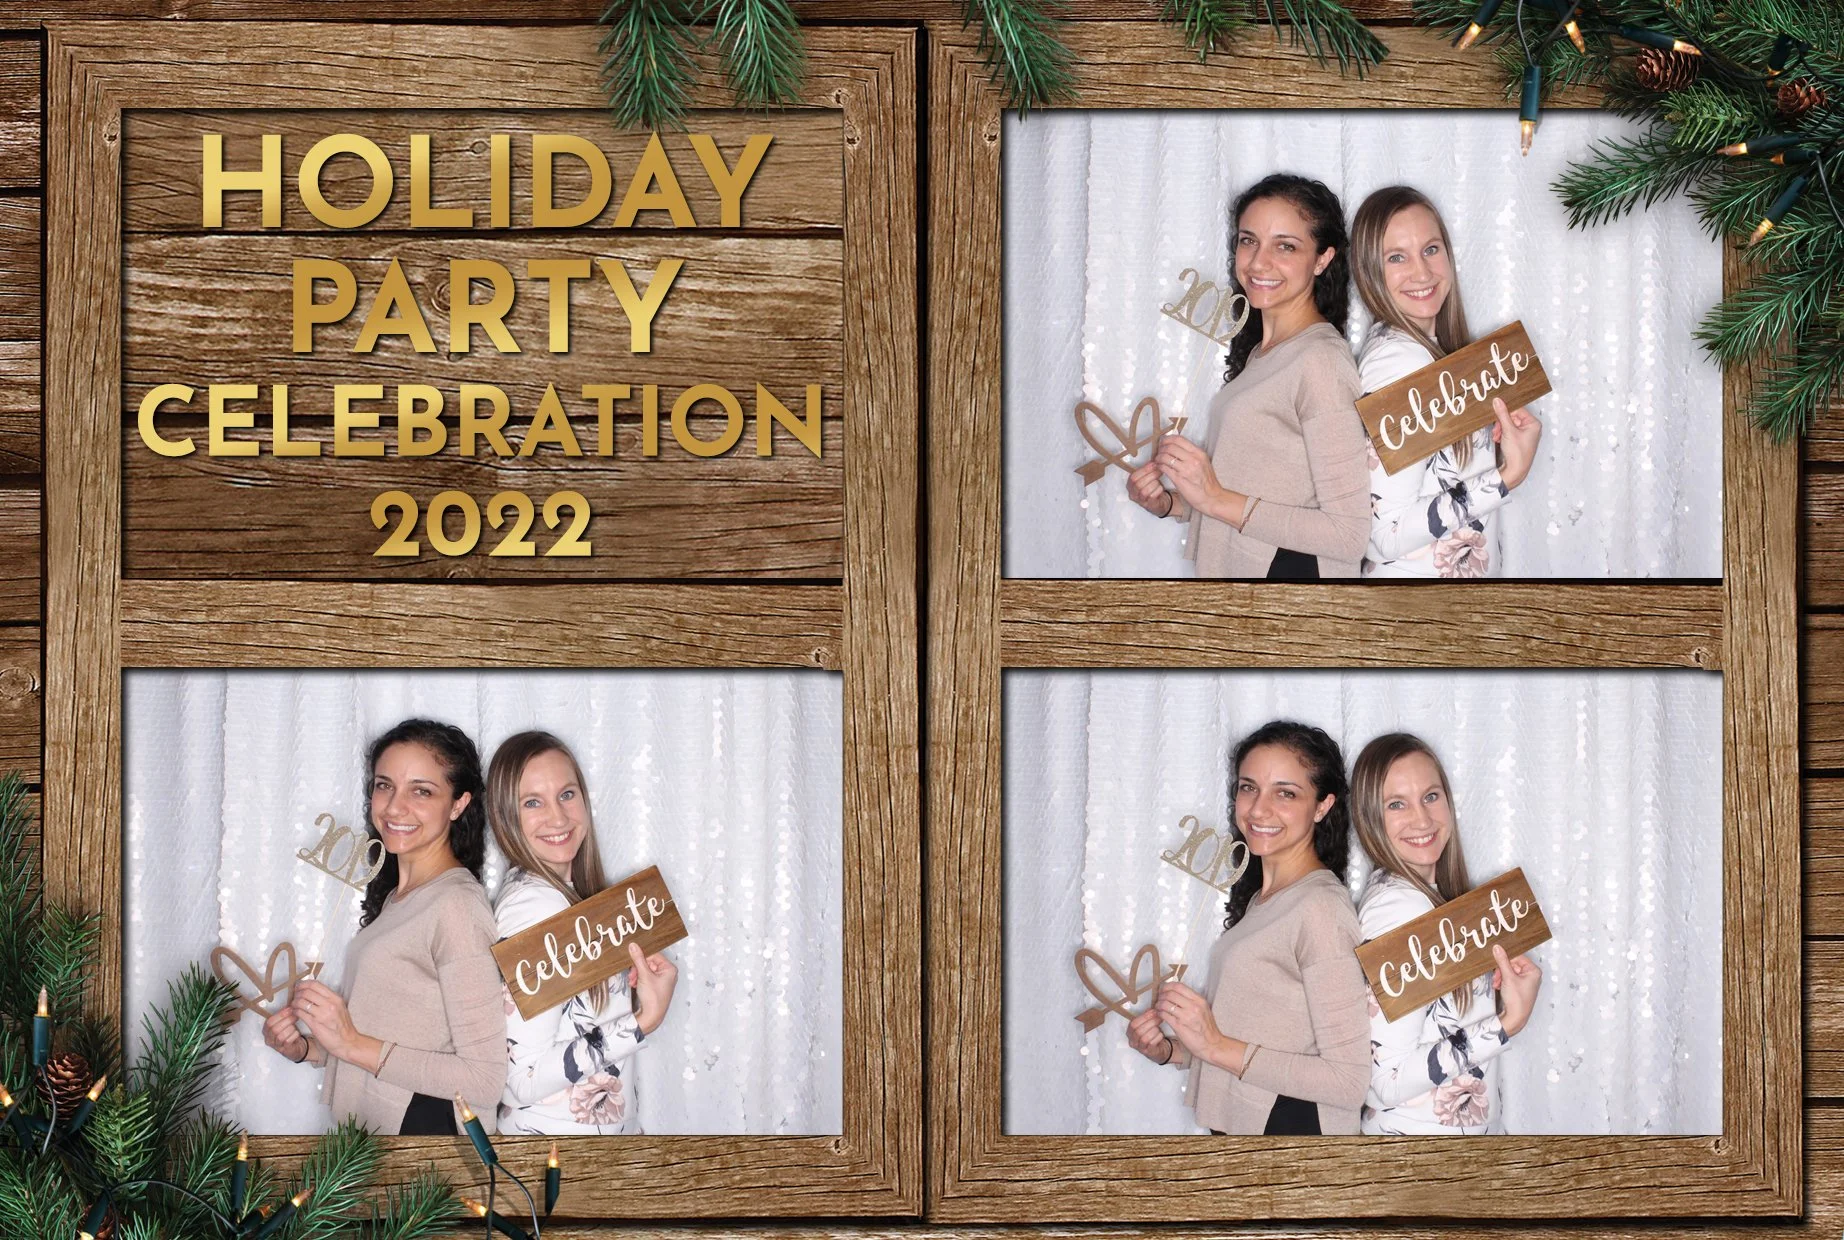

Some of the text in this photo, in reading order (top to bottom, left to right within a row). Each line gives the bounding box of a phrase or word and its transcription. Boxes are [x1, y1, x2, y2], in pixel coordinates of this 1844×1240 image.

[1162, 267, 1250, 343] 2019
[299, 812, 386, 888] 2019
[1162, 814, 1250, 890] 2019
